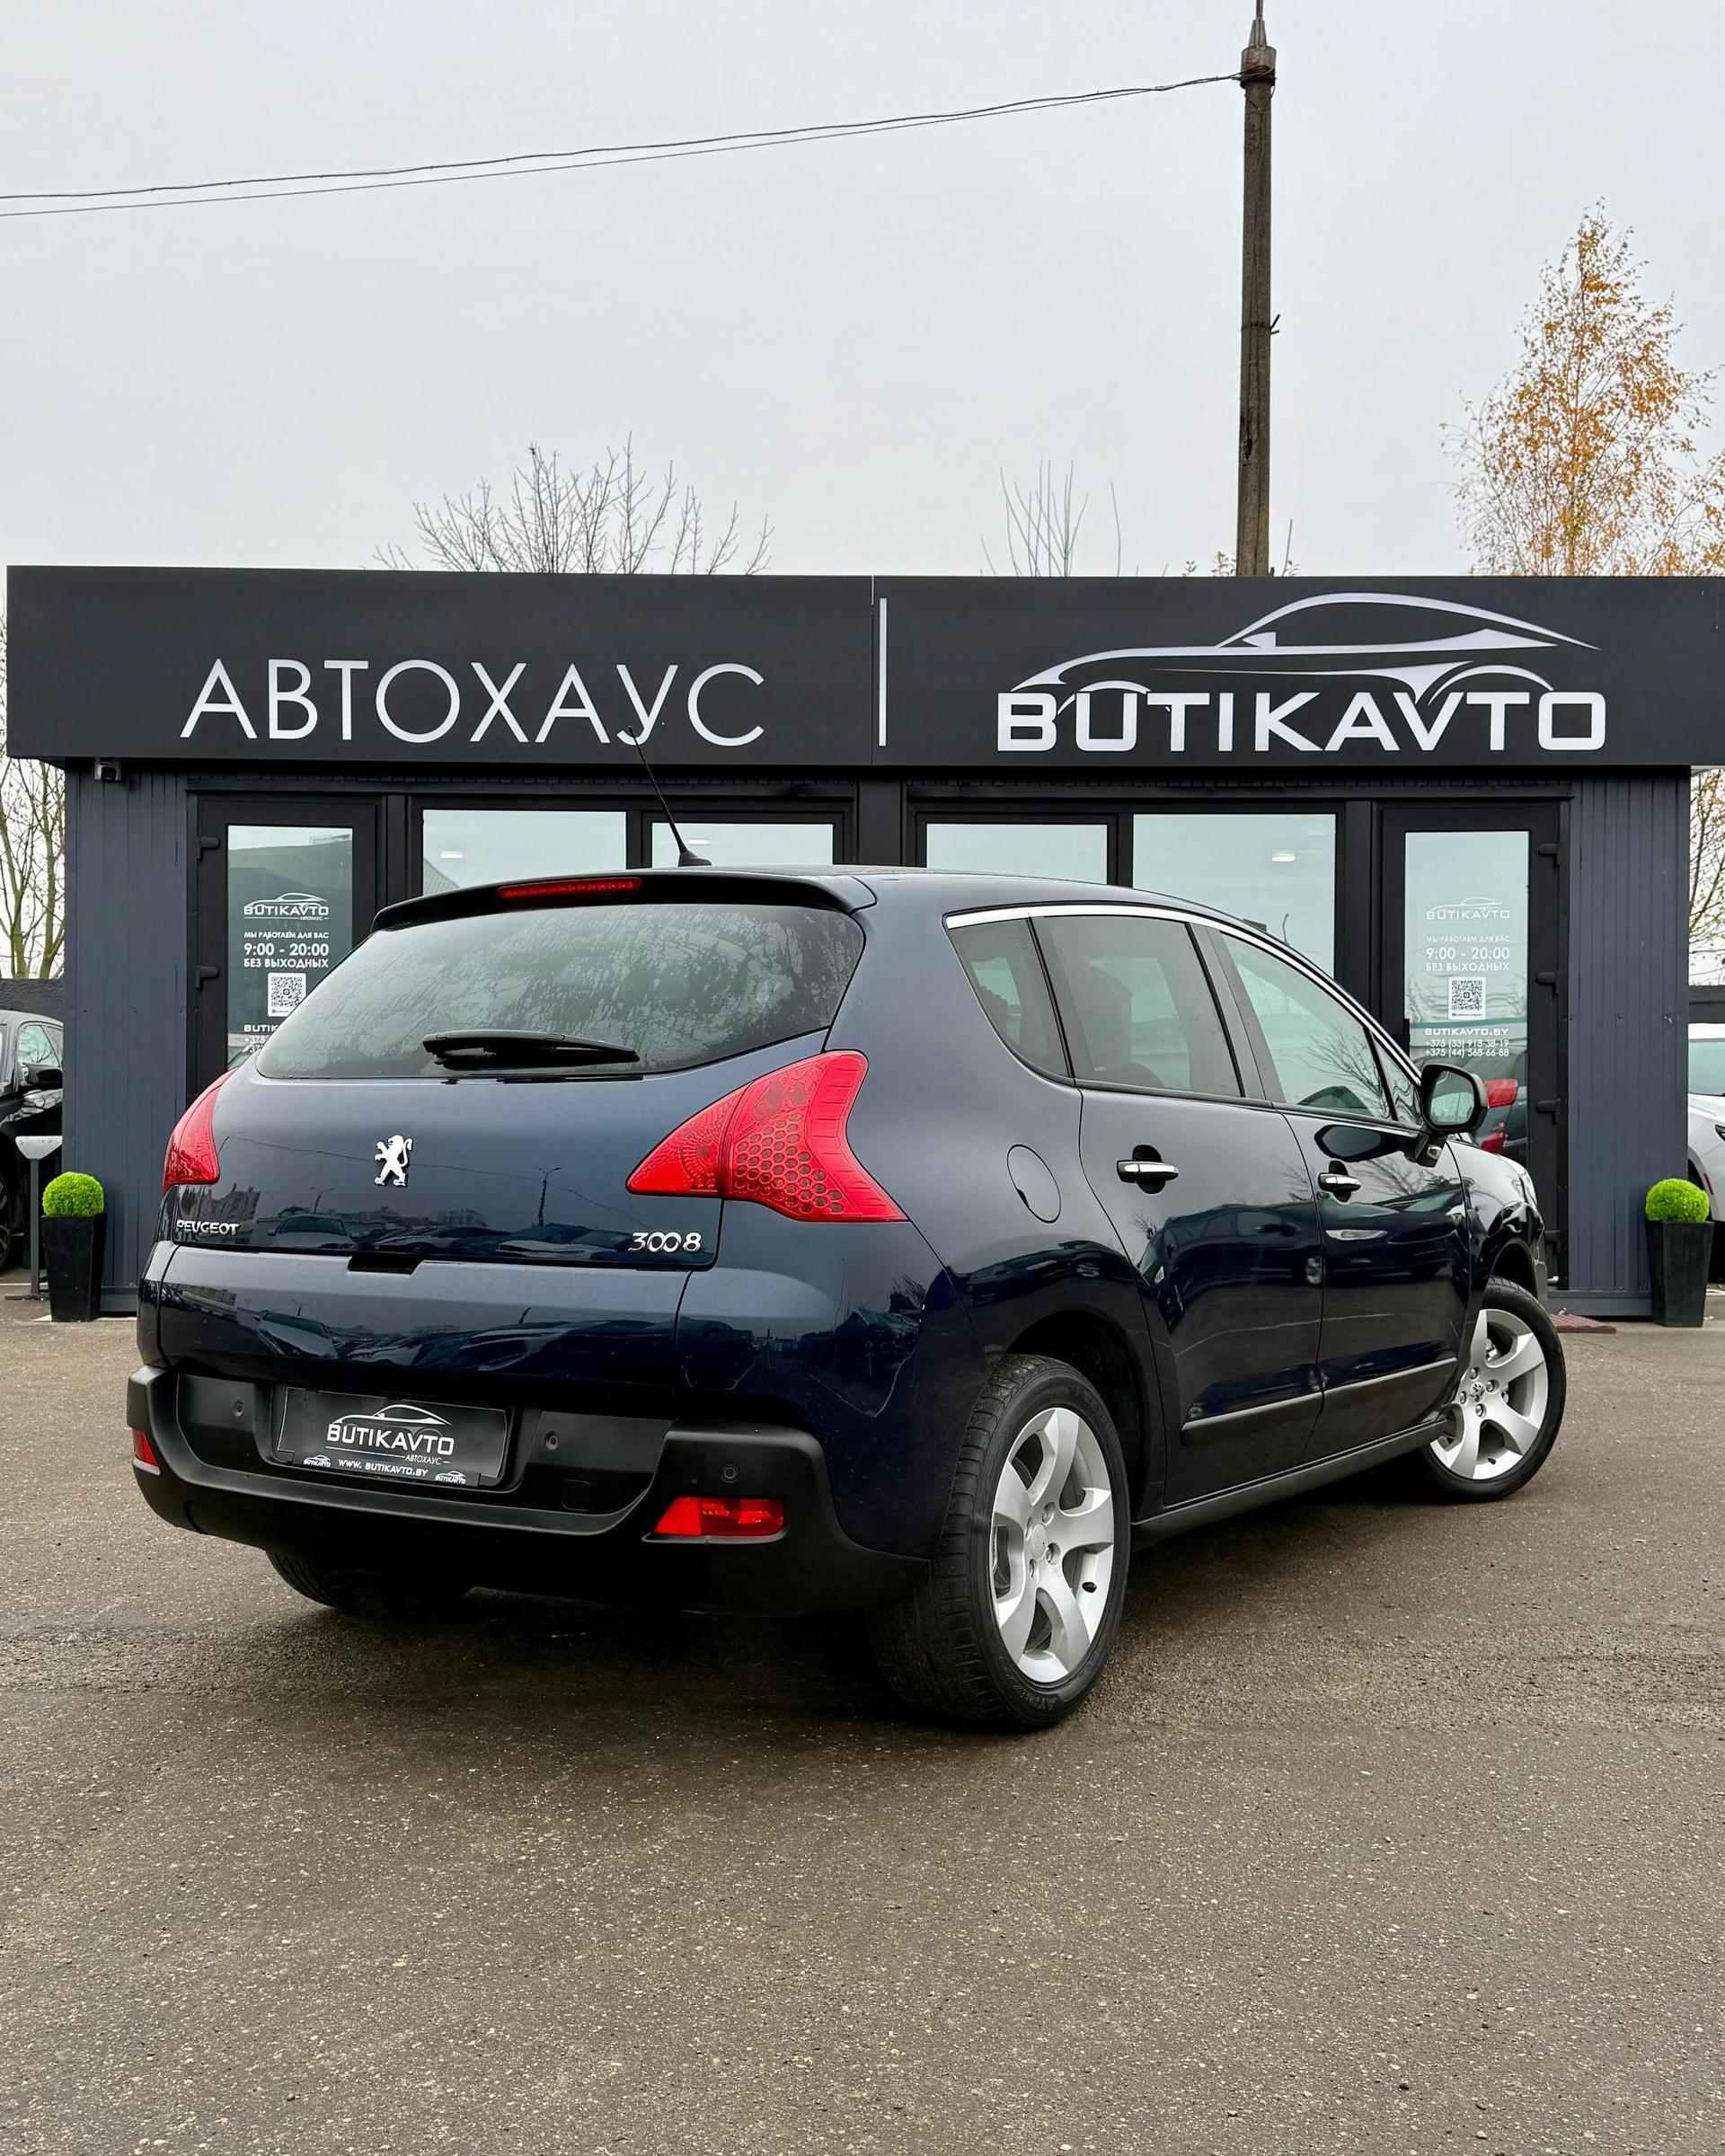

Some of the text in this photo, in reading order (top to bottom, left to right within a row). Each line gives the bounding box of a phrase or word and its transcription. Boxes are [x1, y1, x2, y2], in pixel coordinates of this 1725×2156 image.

[181, 657, 765, 747] АВТОХАУС
[997, 690, 1606, 752] BUTIKAVTO
[243, 905, 330, 915] BUTIKAVTO
[1426, 909, 1510, 920] BUTIKAVTO
[259, 932, 296, 940] РАБОТАЕМ
[243, 943, 275, 956] 9:00
[289, 943, 330, 956] 20:00
[1426, 947, 1455, 959] 9:00
[1472, 947, 1509, 959] 20:00
[243, 959, 329, 968] БЕЗ ВЫХОДНЫХ
[1426, 962, 1509, 972] БЕЗ ВЫХОДНЫХ
[1425, 1028, 1509, 1036] BUTIKAVTO.BY
[1425, 1039, 1509, 1048] +375 (33) 918-38-19
[1425, 1048, 1509, 1057] +375 (44) 568-66-88
[176, 1218, 240, 1237] PEUGEOT
[627, 1231, 702, 1254] 3008
[326, 1423, 455, 1456] BUTIKAVTO
[404, 1454, 442, 1465] АВТОХАУС
[338, 1459, 429, 1477] WWW. BUTIKAVTO.BY
